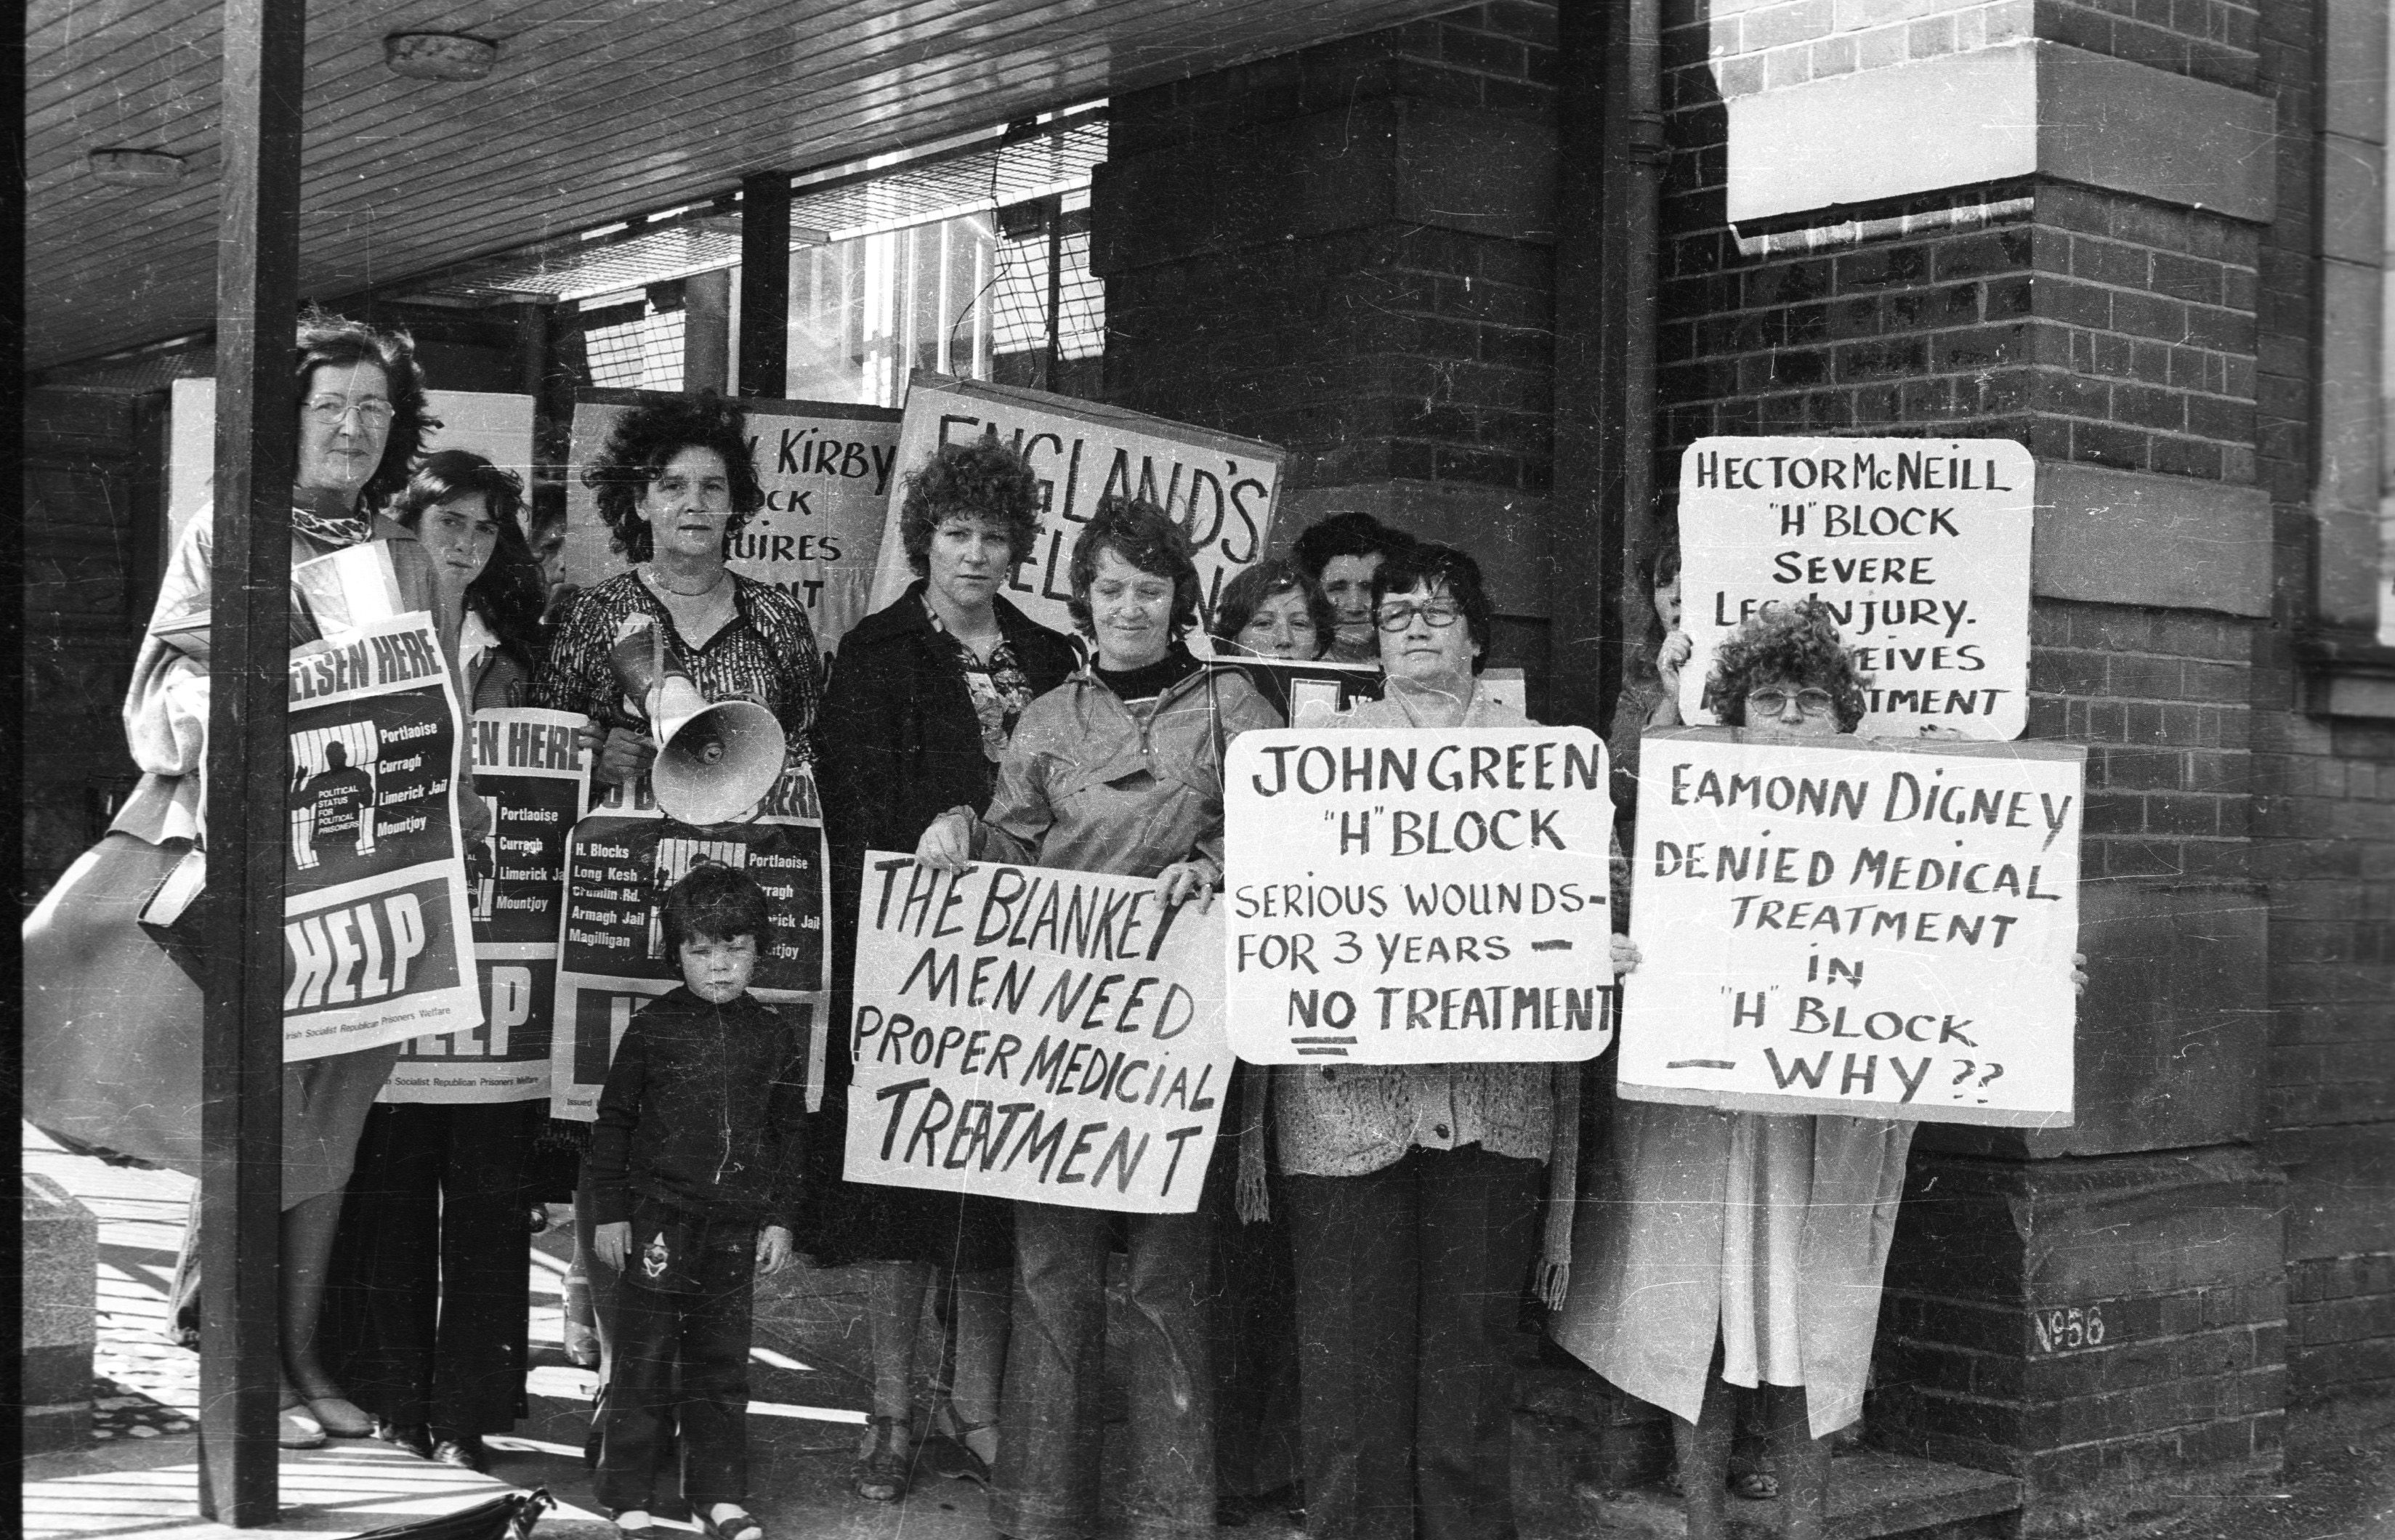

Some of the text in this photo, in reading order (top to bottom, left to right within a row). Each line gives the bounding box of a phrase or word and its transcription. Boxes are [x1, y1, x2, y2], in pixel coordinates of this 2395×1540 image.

[778, 427, 897, 495] KIRBY
[1697, 450, 1846, 490] HECTOR
[938, 414, 1269, 564] EGLAND'S
[1769, 501, 1960, 537] "H" BLOCK
[728, 520, 841, 562] UIRES
[1772, 551, 1935, 585] SEVERE
[290, 628, 443, 702] ELSEN HERE
[1858, 636, 1985, 671] EIVES
[379, 722, 437, 744] Portlaoise
[379, 753, 421, 774] Curragh
[1252, 742, 1599, 797] JOHN GREEN
[318, 785, 358, 798] POLITICAL
[318, 796, 348, 808] STATUS
[379, 779, 448, 806] Limerick Jail
[1671, 763, 2073, 853] EAMONN DIGNEY
[318, 808, 334, 817] FOR
[318, 813, 355, 826] POLITICAL
[318, 820, 359, 835] PRISONERS
[377, 816, 427, 837] Mountjoy
[501, 806, 559, 822] Portlaoise
[499, 836, 543, 855] Curragh
[1324, 806, 1567, 856] "H" BLOCK
[575, 843, 629, 859] H. Blocks
[749, 853, 808, 870] Portlaoise
[1654, 829, 2063, 901] DENIED MEDICAL
[500, 866, 547, 880] Limerick
[574, 865, 637, 882] Long Kesh
[496, 896, 549, 912] Mountjoy
[623, 888, 641, 902] Rd.
[875, 858, 979, 938] THE
[1235, 870, 1388, 918] SERIOUS
[572, 905, 645, 925] Armagh Jail
[801, 915, 820, 930] Jail
[1731, 894, 2019, 949] TREATMENT
[283, 893, 426, 1011] HELP
[569, 928, 630, 949] Magilligan
[1237, 933, 1320, 974] FOR
[1333, 930, 1362, 965] 3
[1376, 932, 1511, 975] YEARS
[897, 947, 1195, 1040] MEN NEED
[1288, 984, 1614, 1032] NO TREATMENT
[286, 1007, 451, 1040] Irish Socialist Republican Prisoners Welfare
[1720, 984, 1979, 1047] "H" BLOCK
[853, 1005, 1022, 1080] PROPER
[395, 1077, 429, 1087] Socialist
[433, 1077, 477, 1087] Republican
[480, 1077, 514, 1087] Prisoners
[567, 1098, 592, 1107] Issued
[876, 1078, 1203, 1198] TREATMENT
